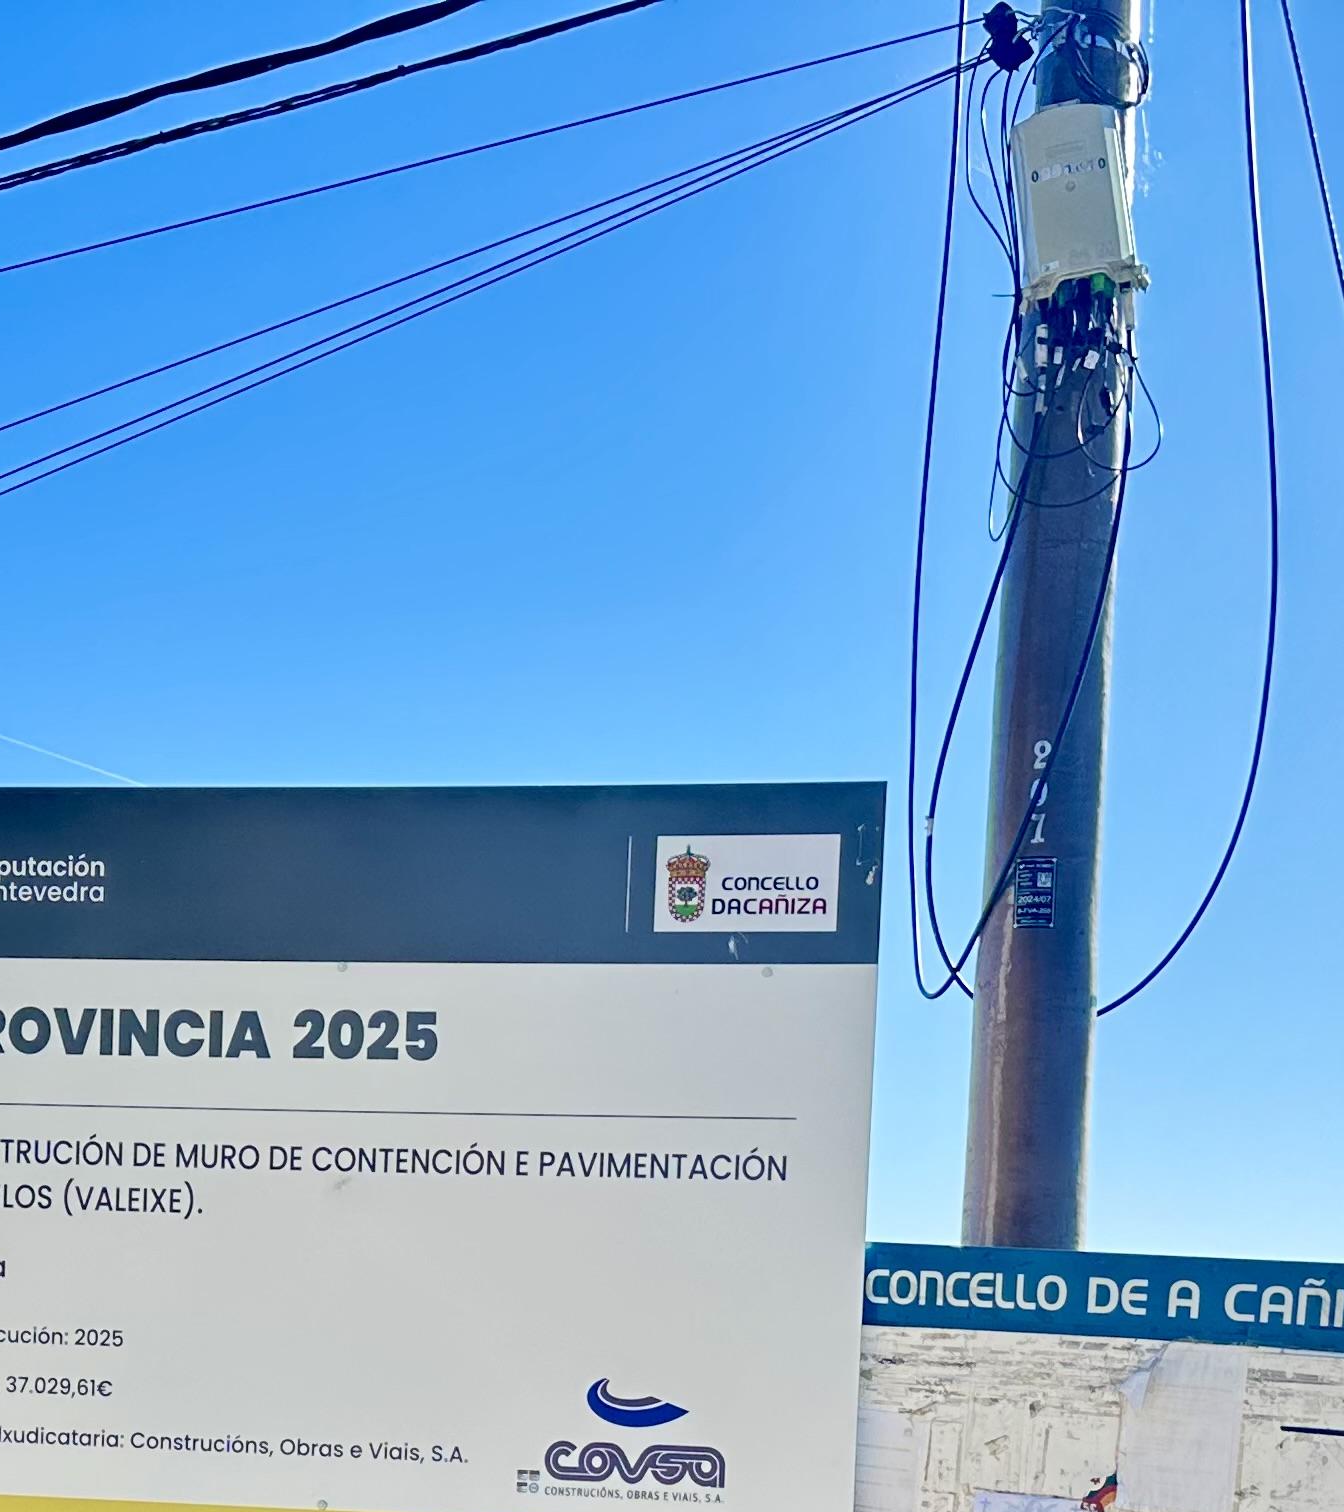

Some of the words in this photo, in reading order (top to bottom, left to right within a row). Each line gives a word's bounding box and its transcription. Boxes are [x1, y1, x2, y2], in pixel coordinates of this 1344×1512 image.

[721, 876, 819, 891] CONCELLO
[292, 1008, 438, 1062] 2025
[132, 1142, 166, 1168] DE
[175, 1143, 260, 1170] MURO
[269, 1145, 303, 1171] DE
[311, 1142, 506, 1176] CONTENCIÓN
[515, 1150, 530, 1177] E
[539, 1146, 788, 1182] PAVIMENTACIÓN
[63, 1177, 203, 1220] (VALEIXE).
[865, 1268, 1068, 1312] CONCELLO
[1086, 1276, 1149, 1316] DE
[1167, 1279, 1201, 1320] A
[74, 1328, 124, 1348] 2025
[6, 1375, 113, 1399] 37.029,61€
[130, 1431, 274, 1458] Construcións,
[279, 1438, 344, 1458] Obras
[349, 1444, 363, 1459] e
[368, 1441, 425, 1465] Viais,
[431, 1445, 468, 1464] S.A.
[626, 1491, 660, 1501] OBRAS
[663, 1492, 669, 1501] E
